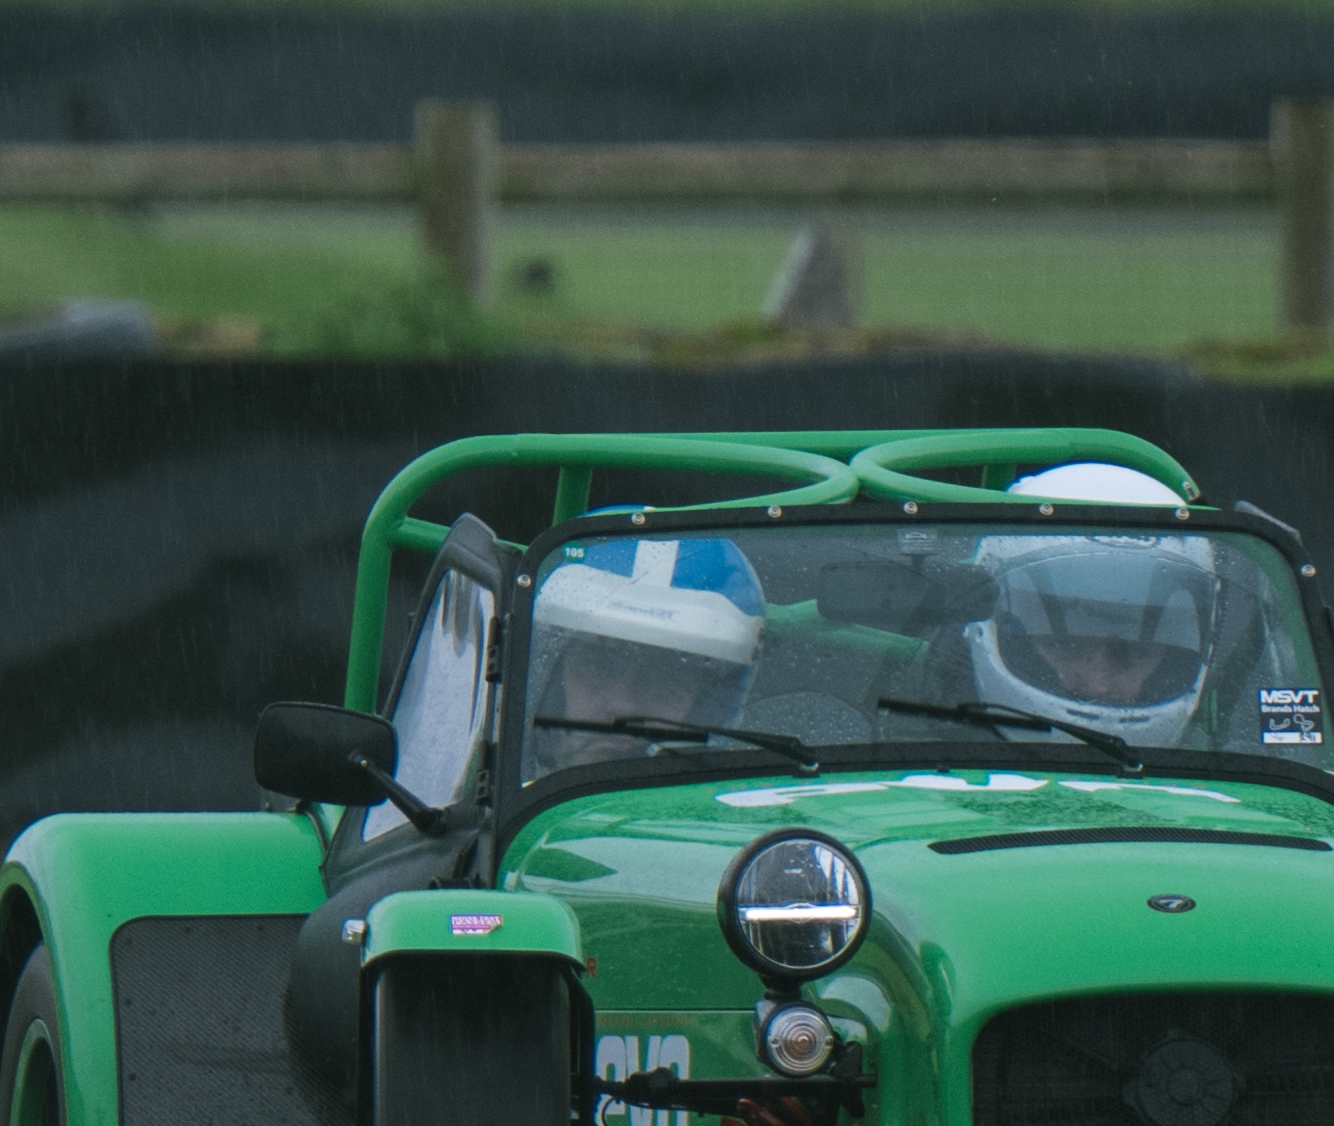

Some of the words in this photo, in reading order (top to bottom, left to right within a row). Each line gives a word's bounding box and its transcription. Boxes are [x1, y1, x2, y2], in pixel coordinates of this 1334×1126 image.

[1260, 690, 1319, 703] MSVT
[1261, 704, 1292, 713] Brands
[1293, 704, 1321, 713] Hatch
